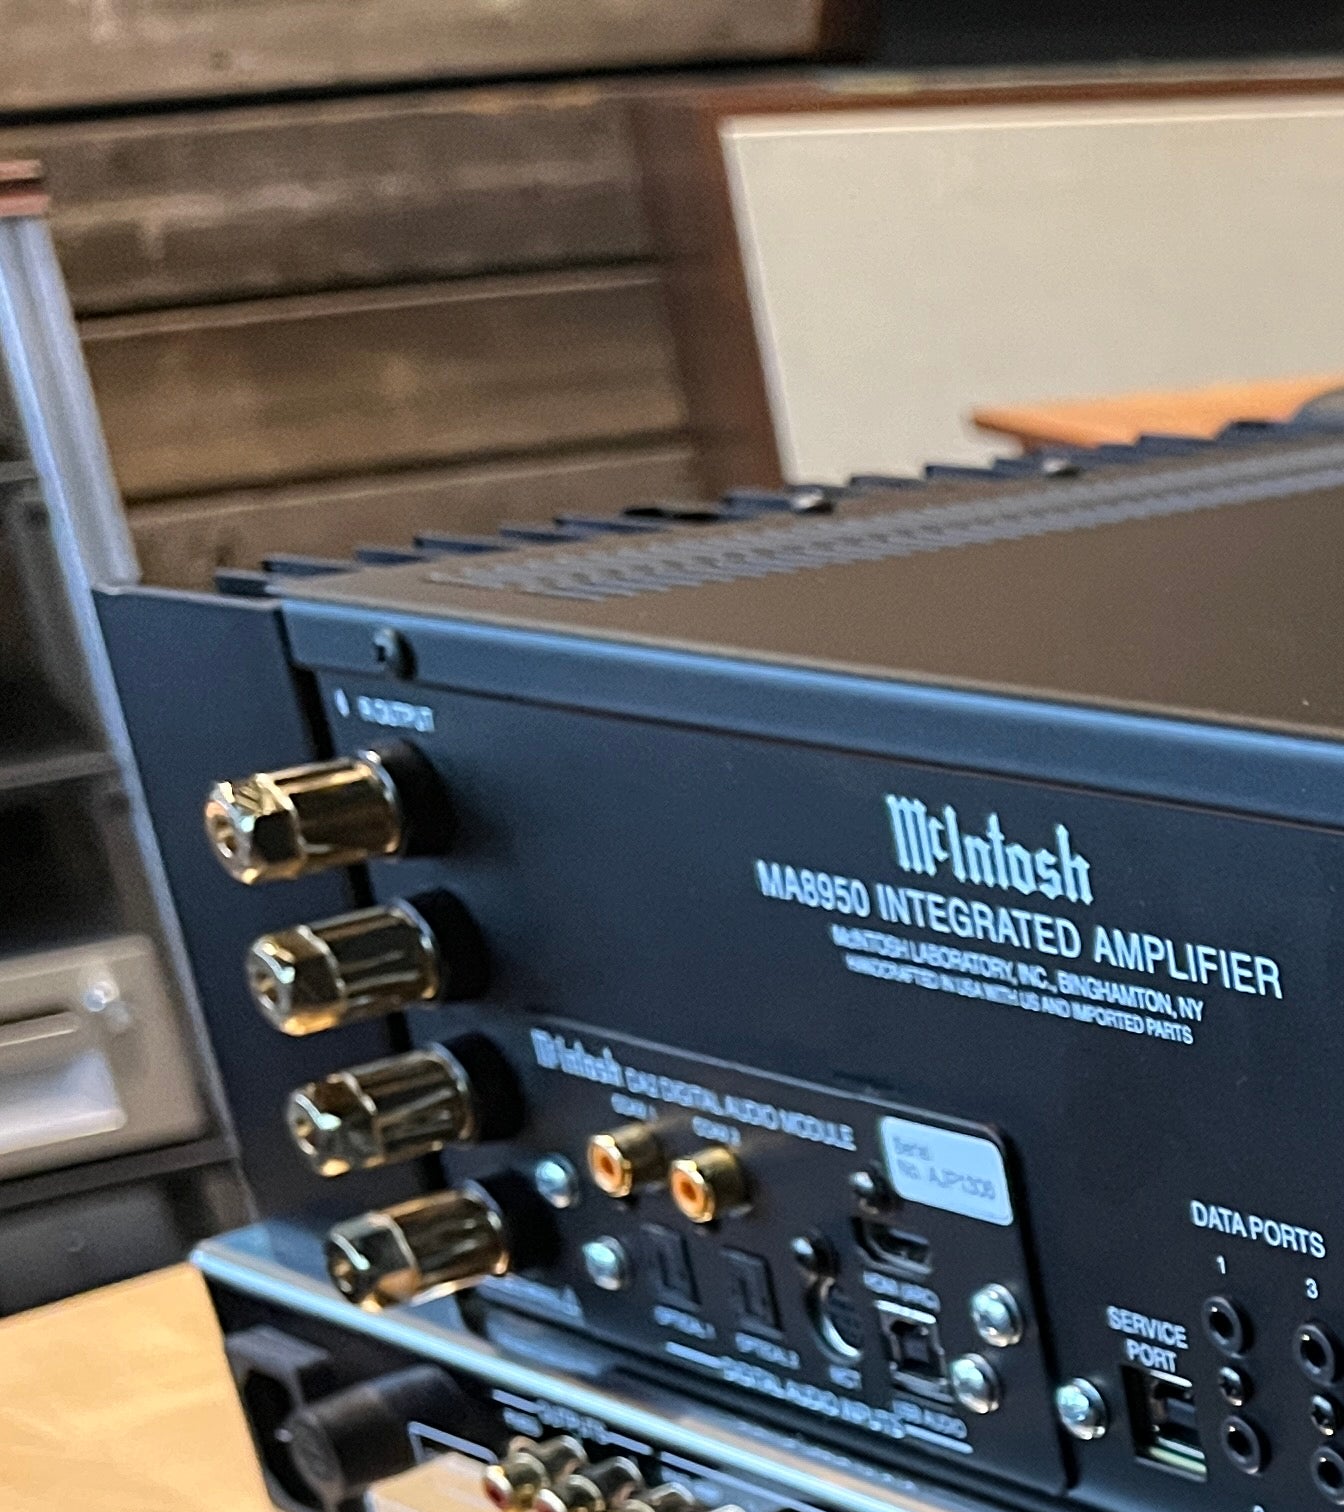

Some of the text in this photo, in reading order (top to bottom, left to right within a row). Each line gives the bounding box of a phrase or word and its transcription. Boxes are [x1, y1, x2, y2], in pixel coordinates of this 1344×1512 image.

[886, 793, 1094, 906] McIntosh
[755, 859, 1283, 1000] MA8950 INTEGRATED AMPLIFIER
[1057, 969, 1177, 1019] BINGHAMTON,
[1177, 996, 1204, 1021] NY
[1070, 1001, 1144, 1034] IMPORTED
[1145, 1016, 1194, 1045] PARTS
[1190, 1200, 1326, 1259] DATA PORTS
[1215, 1255, 1226, 1275] 1
[1304, 1277, 1319, 1300] 3
[1106, 1305, 1189, 1350] SERVICE
[1125, 1337, 1178, 1374] PORT
